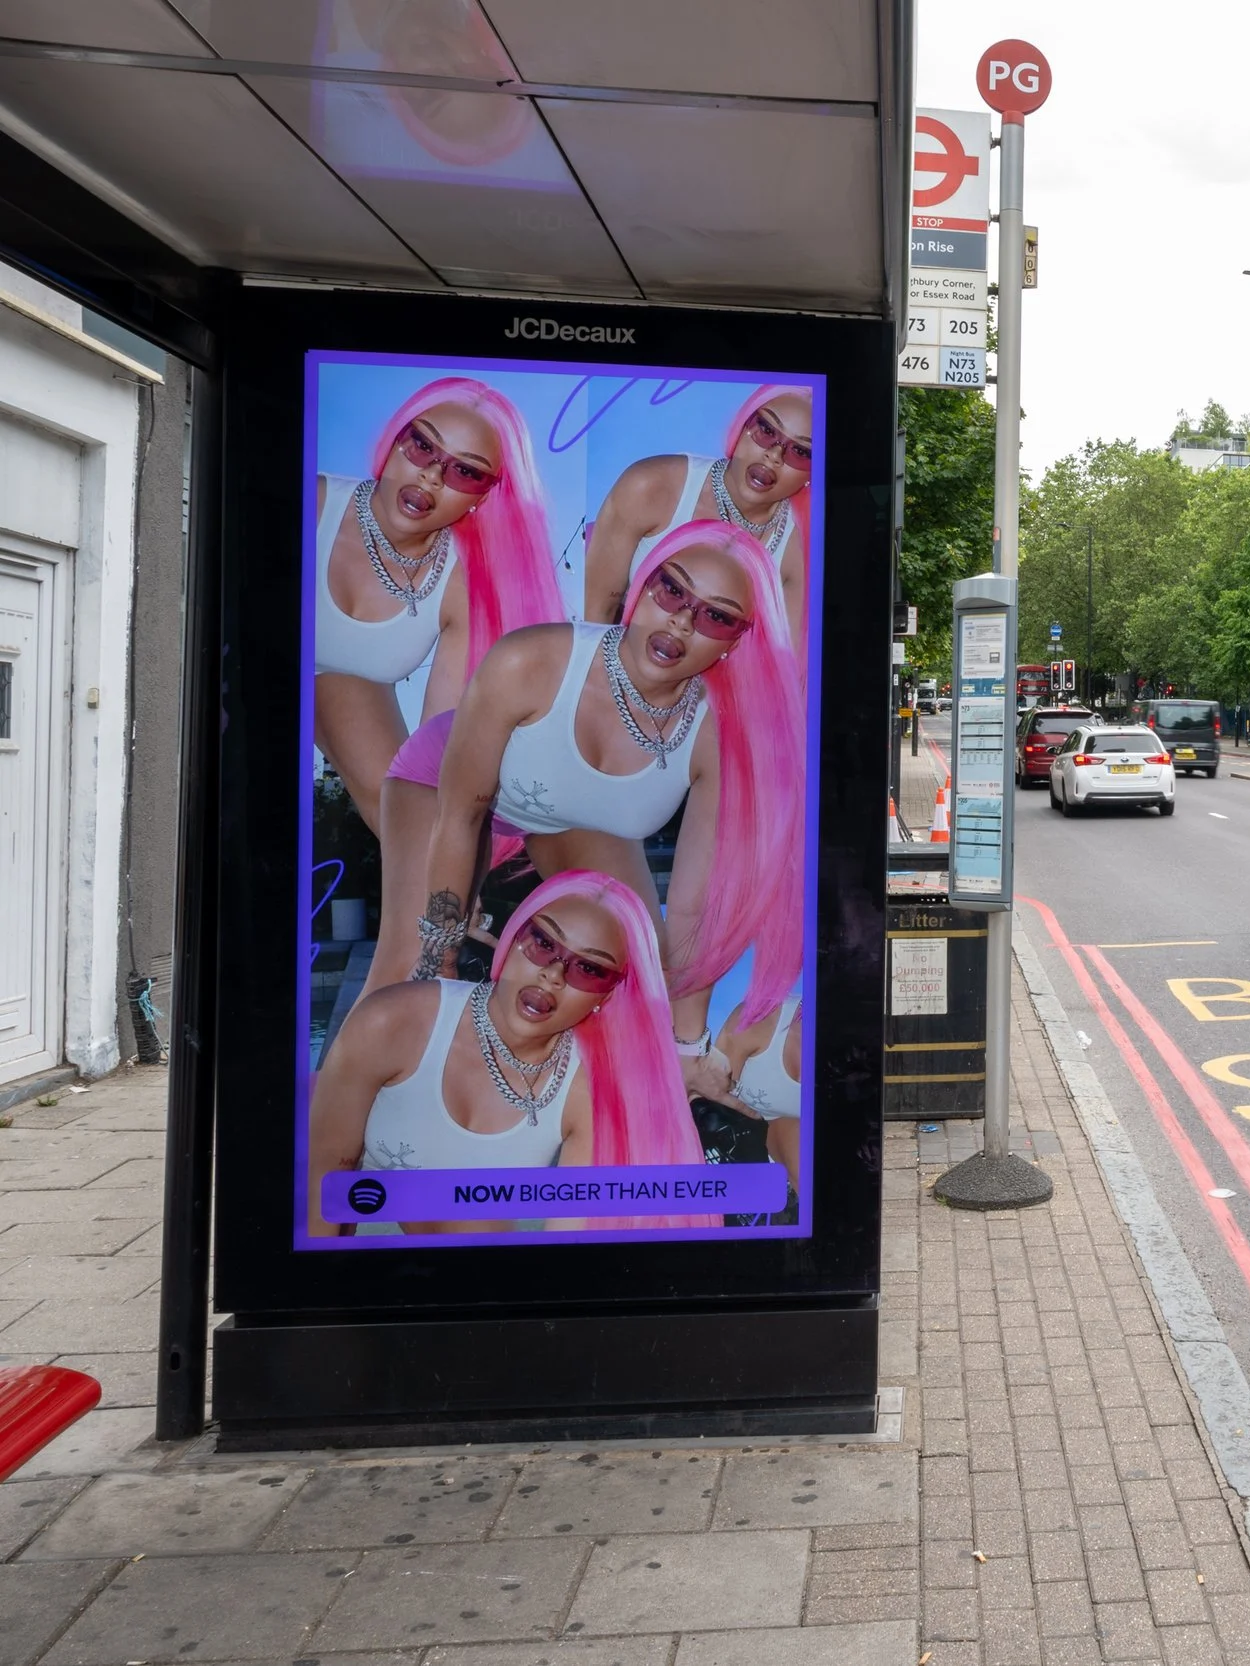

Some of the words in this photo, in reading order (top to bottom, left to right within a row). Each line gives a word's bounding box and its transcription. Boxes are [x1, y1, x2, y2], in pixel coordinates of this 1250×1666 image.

[988, 60, 1040, 93] PG
[916, 217, 944, 227] STOP
[928, 240, 954, 253] Rise
[942, 278, 976, 290] Corner,
[923, 290, 949, 299] Essex
[952, 292, 976, 301] Road
[504, 317, 636, 344] JCDecaux
[908, 318, 926, 332] 73
[949, 320, 978, 335] 205
[950, 350, 965, 358] Night
[901, 356, 930, 370] 476
[949, 358, 976, 370] N73
[945, 371, 980, 383] N205
[899, 913, 947, 928] Litter
[895, 966, 944, 977] Dumping
[453, 1184, 515, 1204] NOW
[519, 1183, 601, 1202] BIGGER
[605, 1181, 668, 1200] THAN
[674, 1180, 728, 1199] EVER
